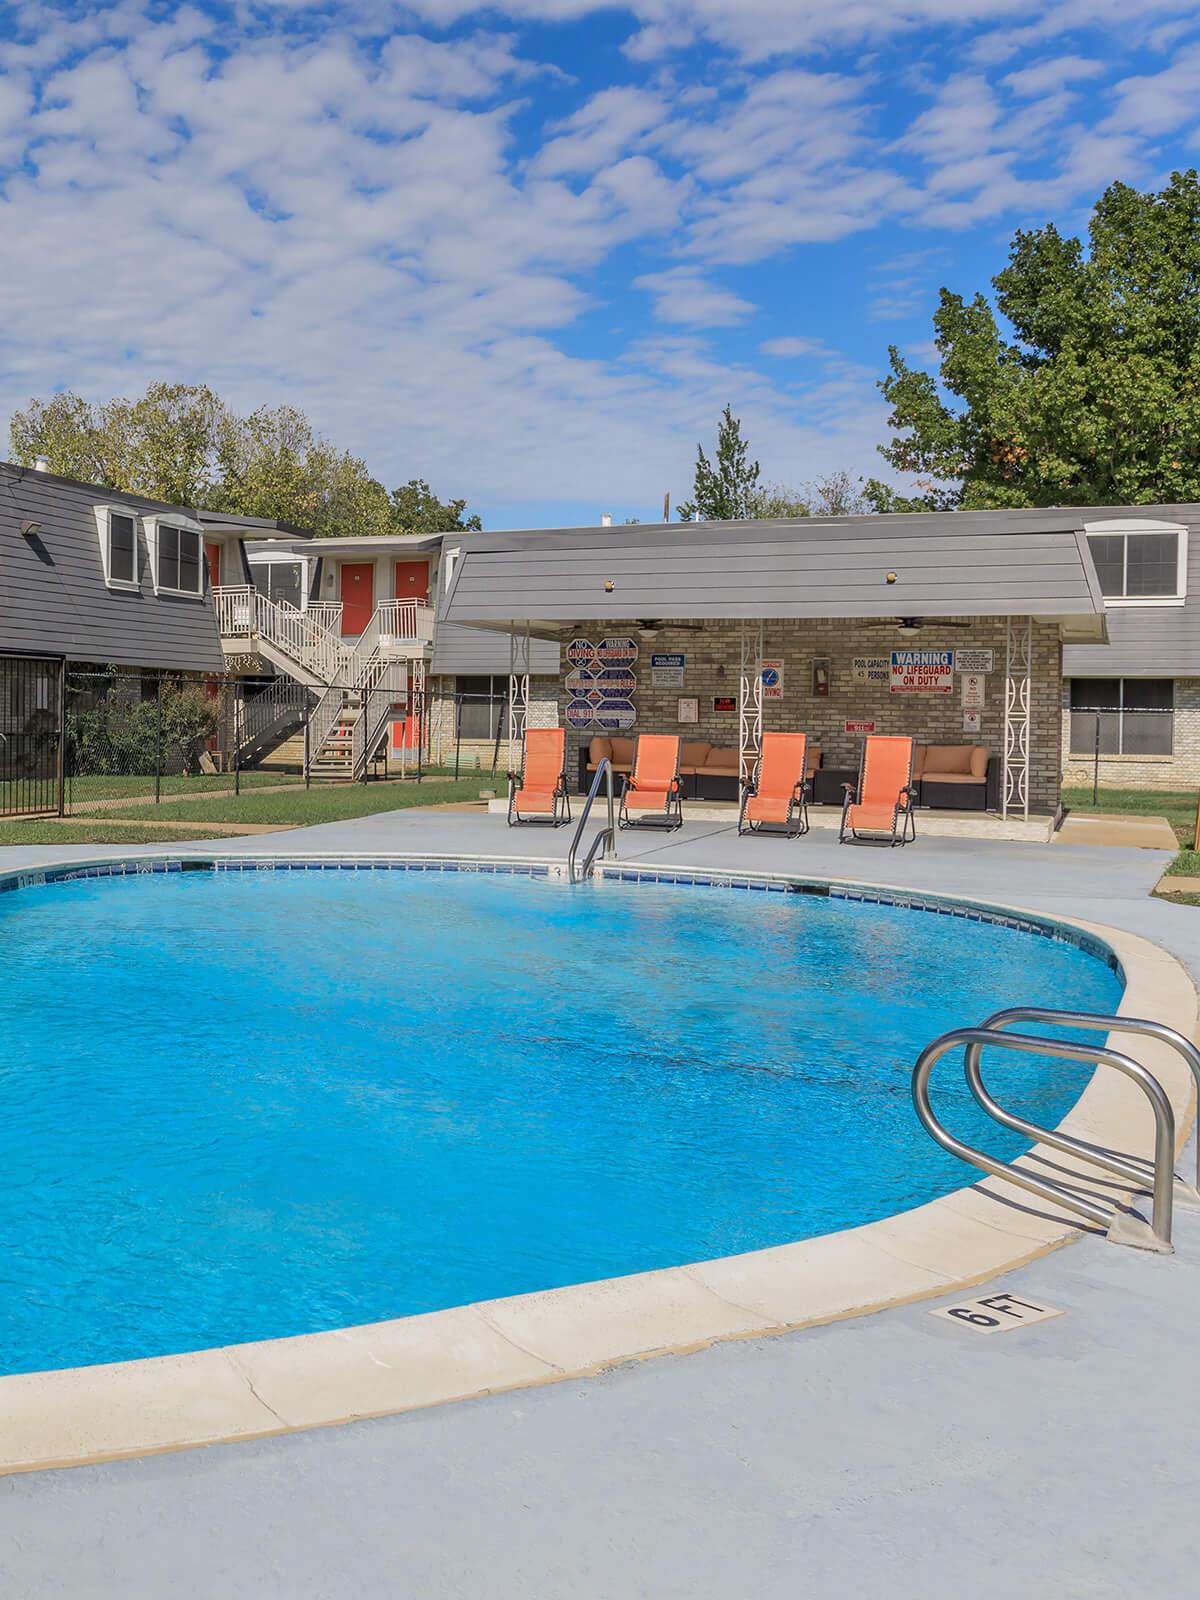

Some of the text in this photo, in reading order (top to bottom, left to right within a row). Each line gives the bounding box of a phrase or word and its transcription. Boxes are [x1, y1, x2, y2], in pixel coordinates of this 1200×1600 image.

[576, 640, 587, 649] NO
[606, 640, 630, 648] WARNING
[568, 649, 594, 657] DIVING
[854, 659, 867, 668] POOL
[895, 653, 948, 665] WARNING
[892, 665, 951, 675] NO LIFEGUARD
[867, 670, 889, 680] PERSONS
[903, 676, 939, 685] ON DUTY
[764, 688, 780, 697] DIVING
[947, 1293, 1045, 1327] 6 FT
